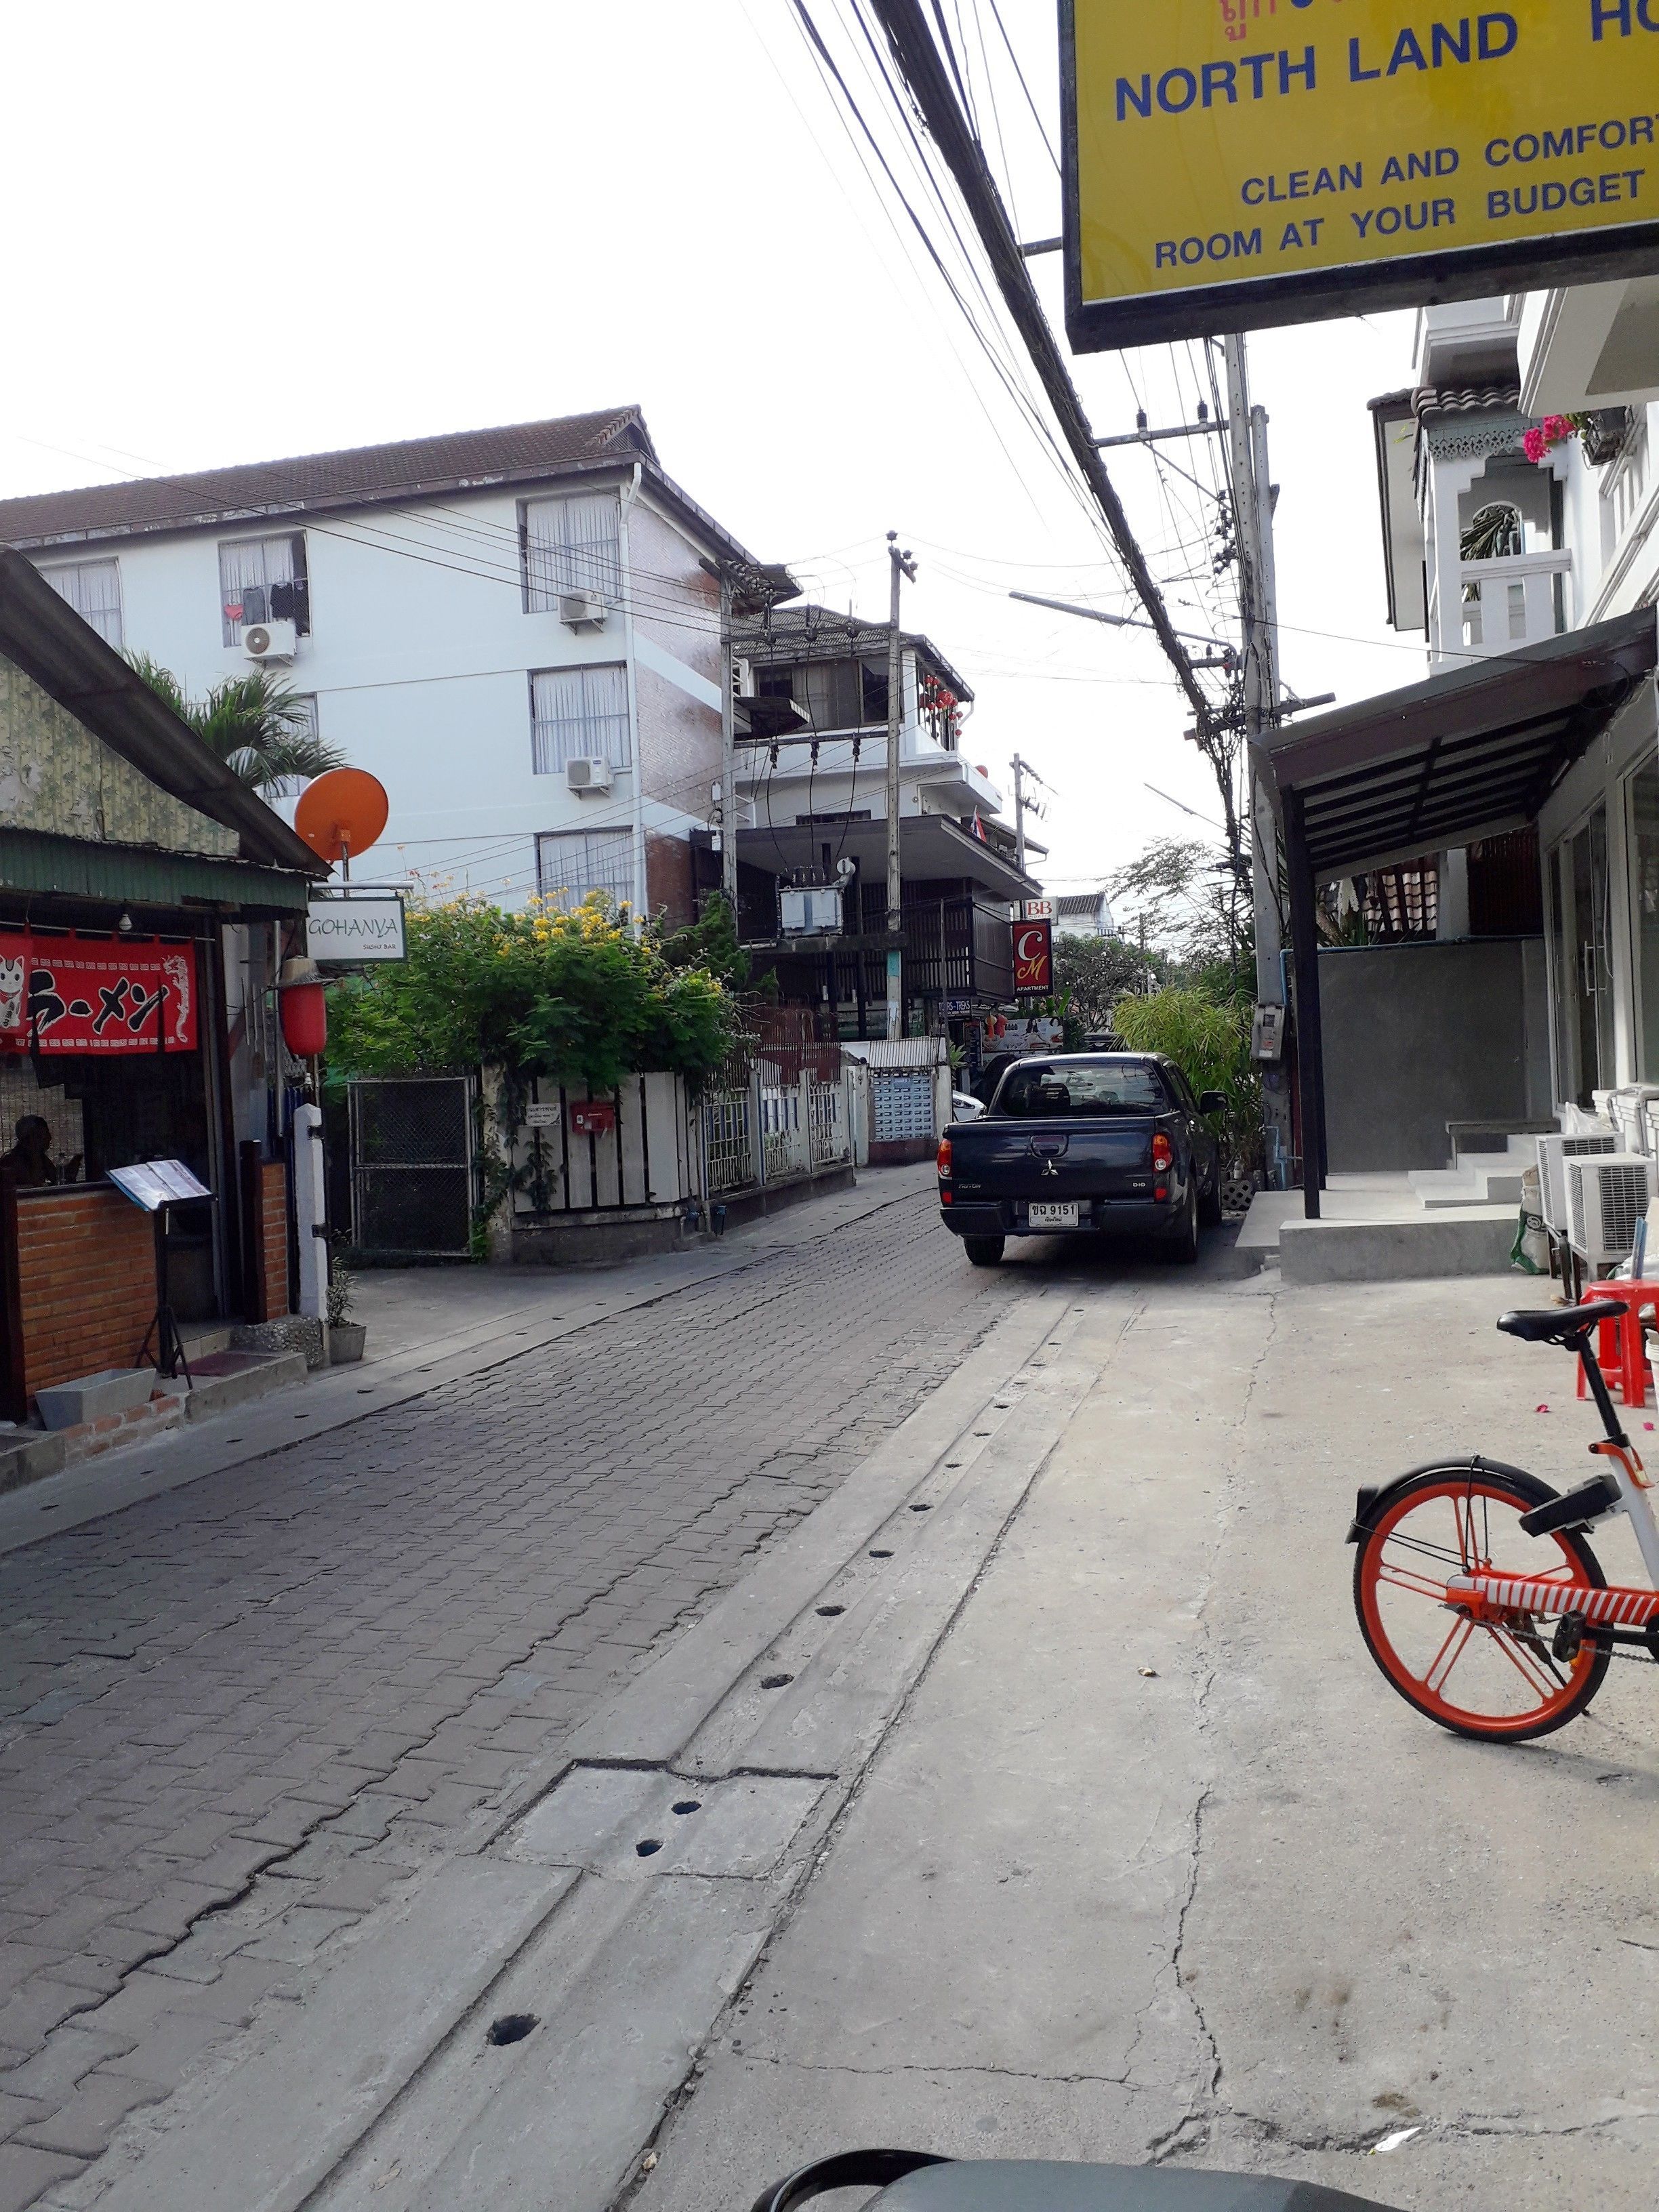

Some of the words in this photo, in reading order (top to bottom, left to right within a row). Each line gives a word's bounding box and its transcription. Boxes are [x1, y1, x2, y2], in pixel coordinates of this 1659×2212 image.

[1115, 46, 1315, 122] NORTH
[1349, 13, 1517, 82] LAND
[1241, 162, 1362, 206] CLEAN
[1381, 148, 1459, 185] AND
[1485, 114, 1659, 167] COMFOR
[1155, 228, 1262, 268] ROOM
[1280, 219, 1324, 251] AT
[1351, 199, 1455, 239] YOUR
[1488, 169, 1645, 220] BUDGET
[1027, 901, 1052, 915] BB
[26, 969, 169, 1037] ラーメン
[938, 1000, 970, 1011] TRS-TREKS
[1050, 1205, 1074, 1215] 9151
